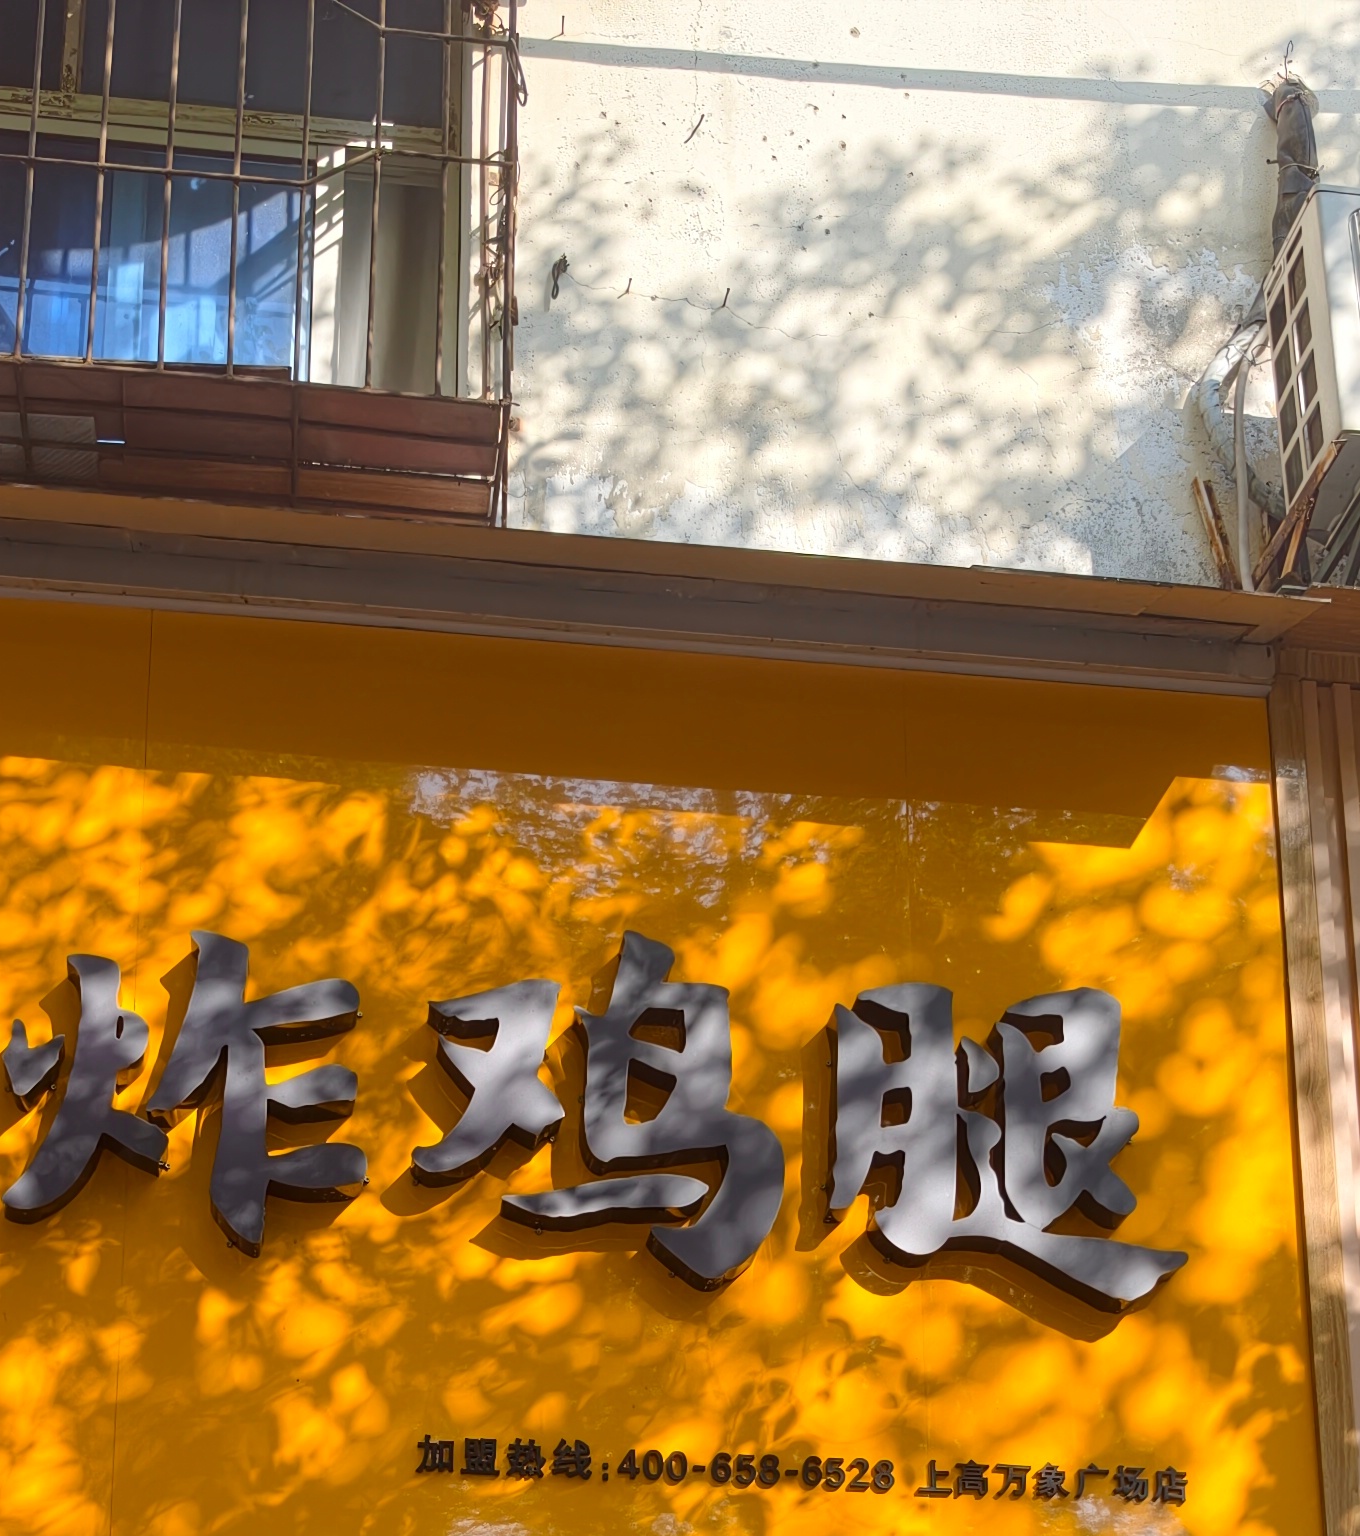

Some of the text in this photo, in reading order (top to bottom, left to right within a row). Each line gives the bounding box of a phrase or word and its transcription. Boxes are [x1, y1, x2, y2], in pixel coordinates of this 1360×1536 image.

[416, 1434, 1189, 1507] 加盟热线:400-658-6528 上高万象广场店
